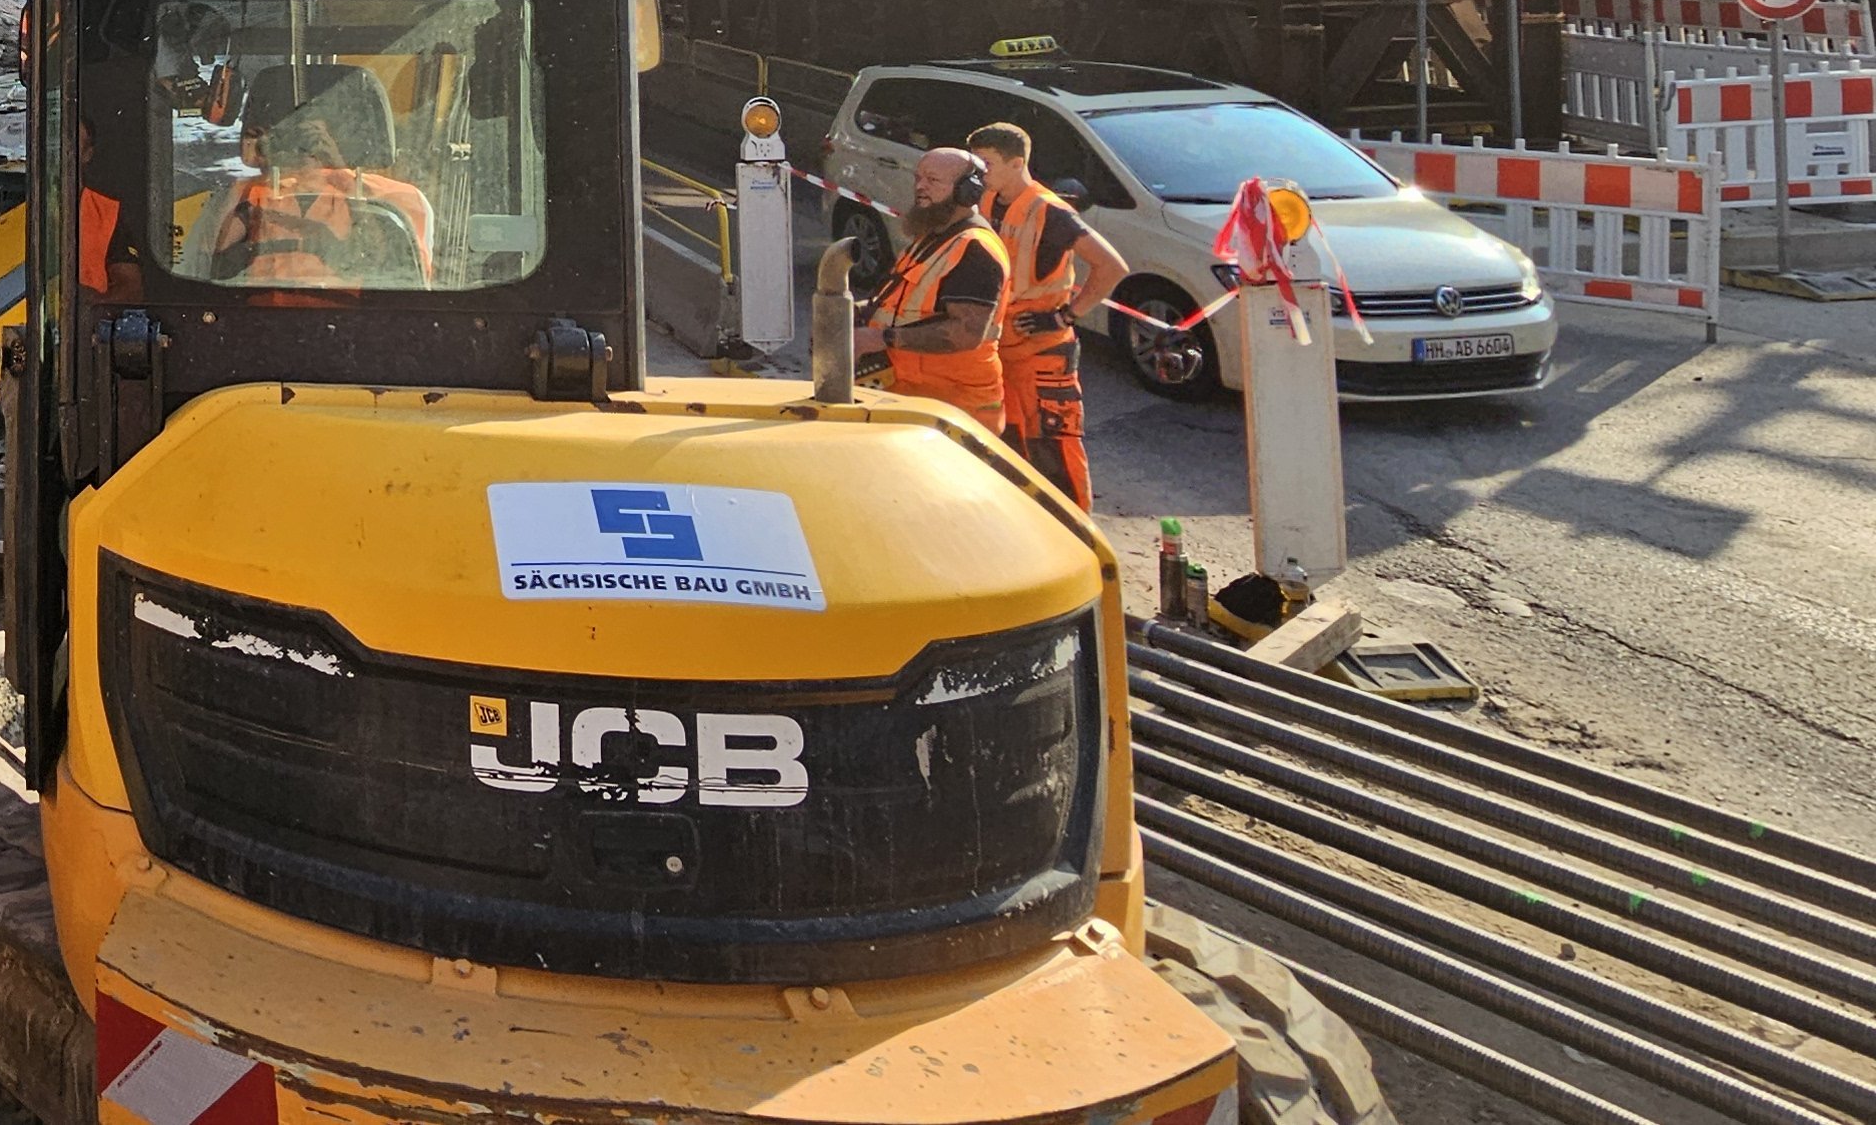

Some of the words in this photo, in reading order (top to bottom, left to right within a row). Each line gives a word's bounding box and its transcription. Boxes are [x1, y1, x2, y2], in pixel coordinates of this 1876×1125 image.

[1009, 37, 1050, 52] TAXI
[1455, 340, 1474, 357] AB
[1476, 337, 1510, 356] 6604
[513, 570, 667, 591] SÄCHSISCHE
[674, 575, 728, 593] BAU
[736, 579, 812, 601] GMBH
[479, 704, 501, 724] JCB
[471, 701, 809, 807] JCB
